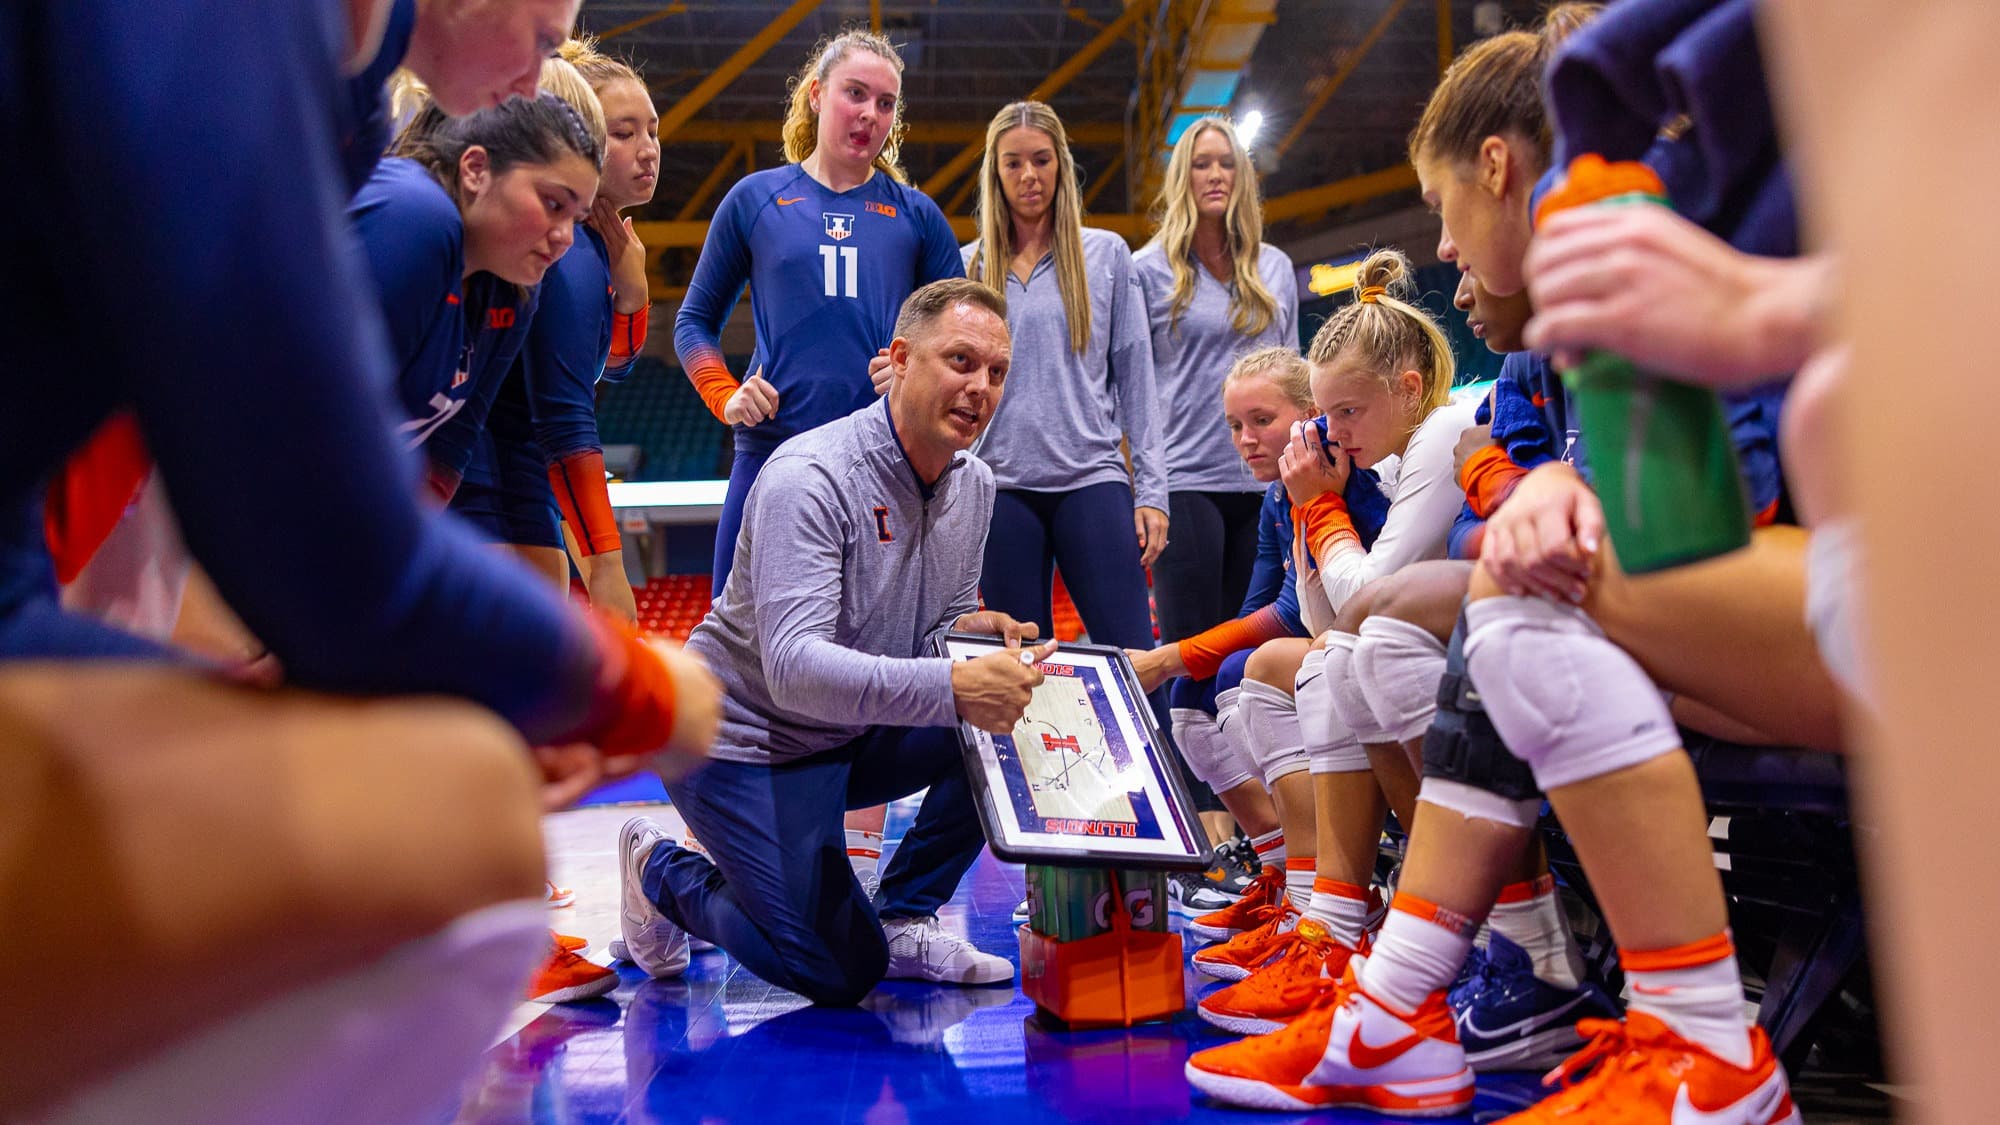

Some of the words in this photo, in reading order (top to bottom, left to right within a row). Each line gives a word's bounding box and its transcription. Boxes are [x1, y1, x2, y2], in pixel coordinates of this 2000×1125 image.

[819, 244, 858, 298] 11
[872, 505, 893, 543] I
[1045, 818, 1137, 837] ILLINOIS
